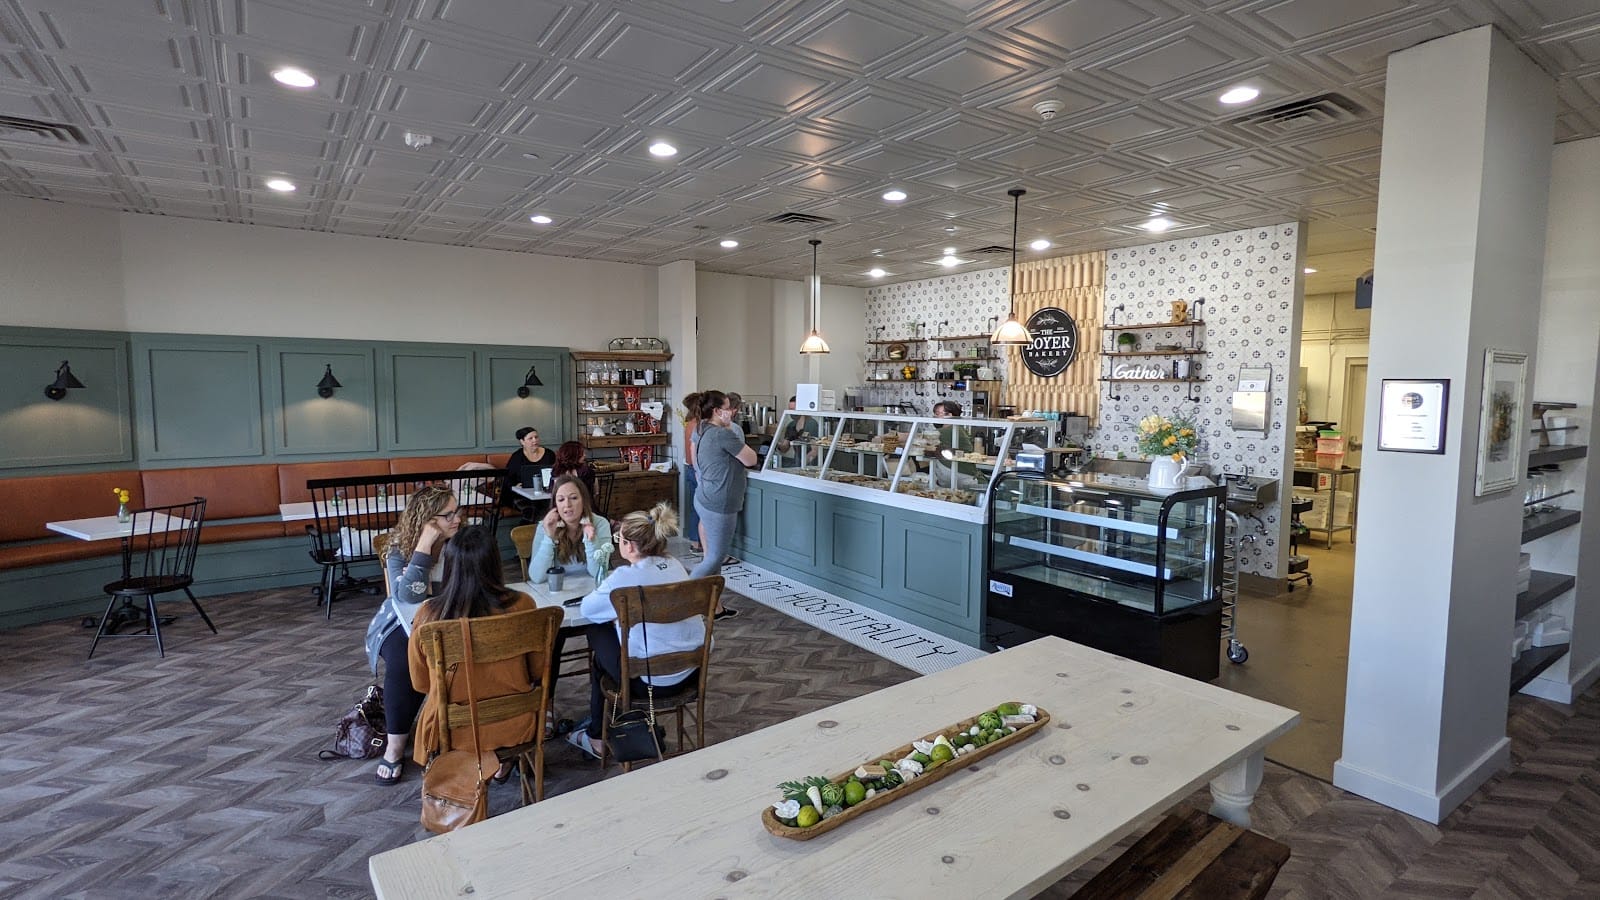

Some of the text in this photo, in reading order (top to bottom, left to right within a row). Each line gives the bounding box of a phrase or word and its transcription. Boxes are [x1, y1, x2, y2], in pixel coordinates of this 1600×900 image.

[1113, 363, 1166, 380] Gather
[749, 580, 792, 592] OF
[776, 591, 958, 659] HOSPITALITY
